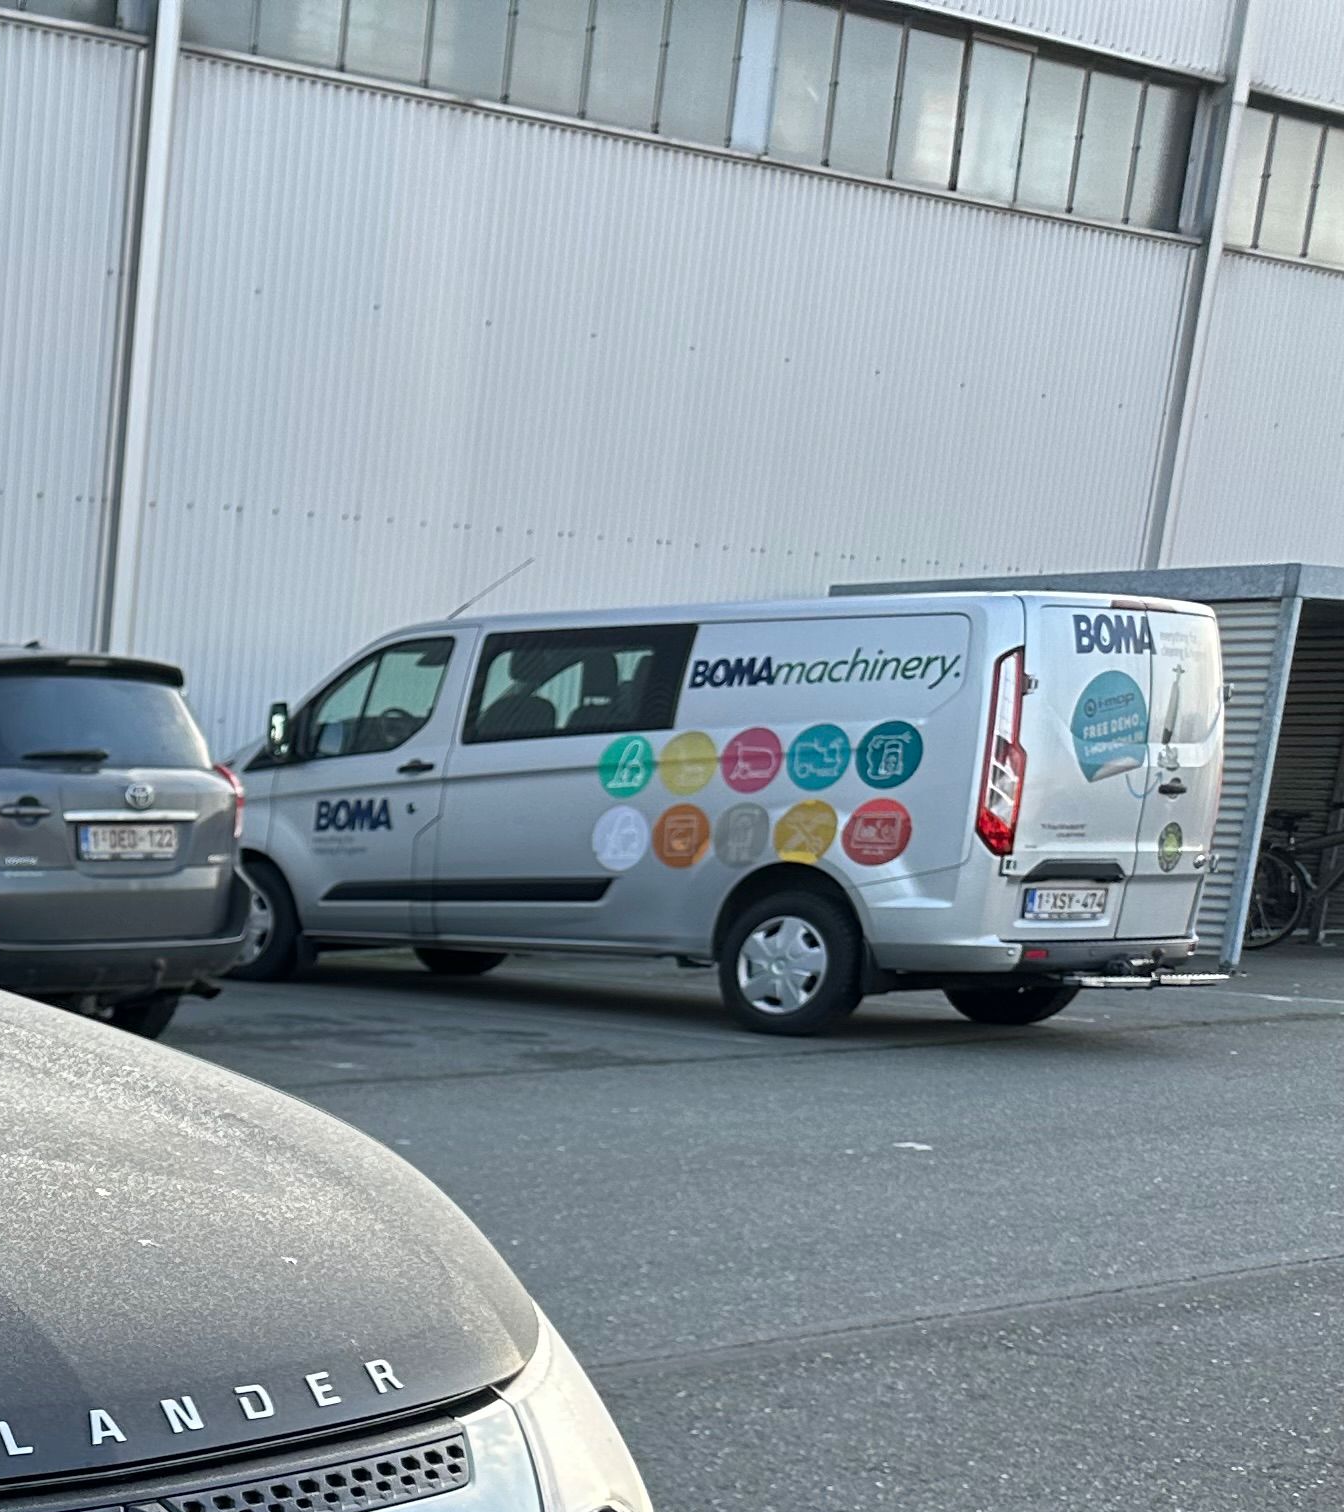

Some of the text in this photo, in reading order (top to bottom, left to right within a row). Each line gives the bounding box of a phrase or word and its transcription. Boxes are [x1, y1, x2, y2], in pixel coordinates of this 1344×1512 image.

[1072, 614, 1157, 655] BOMA
[1082, 720, 1109, 740] FREE
[315, 799, 392, 832] BOMA
